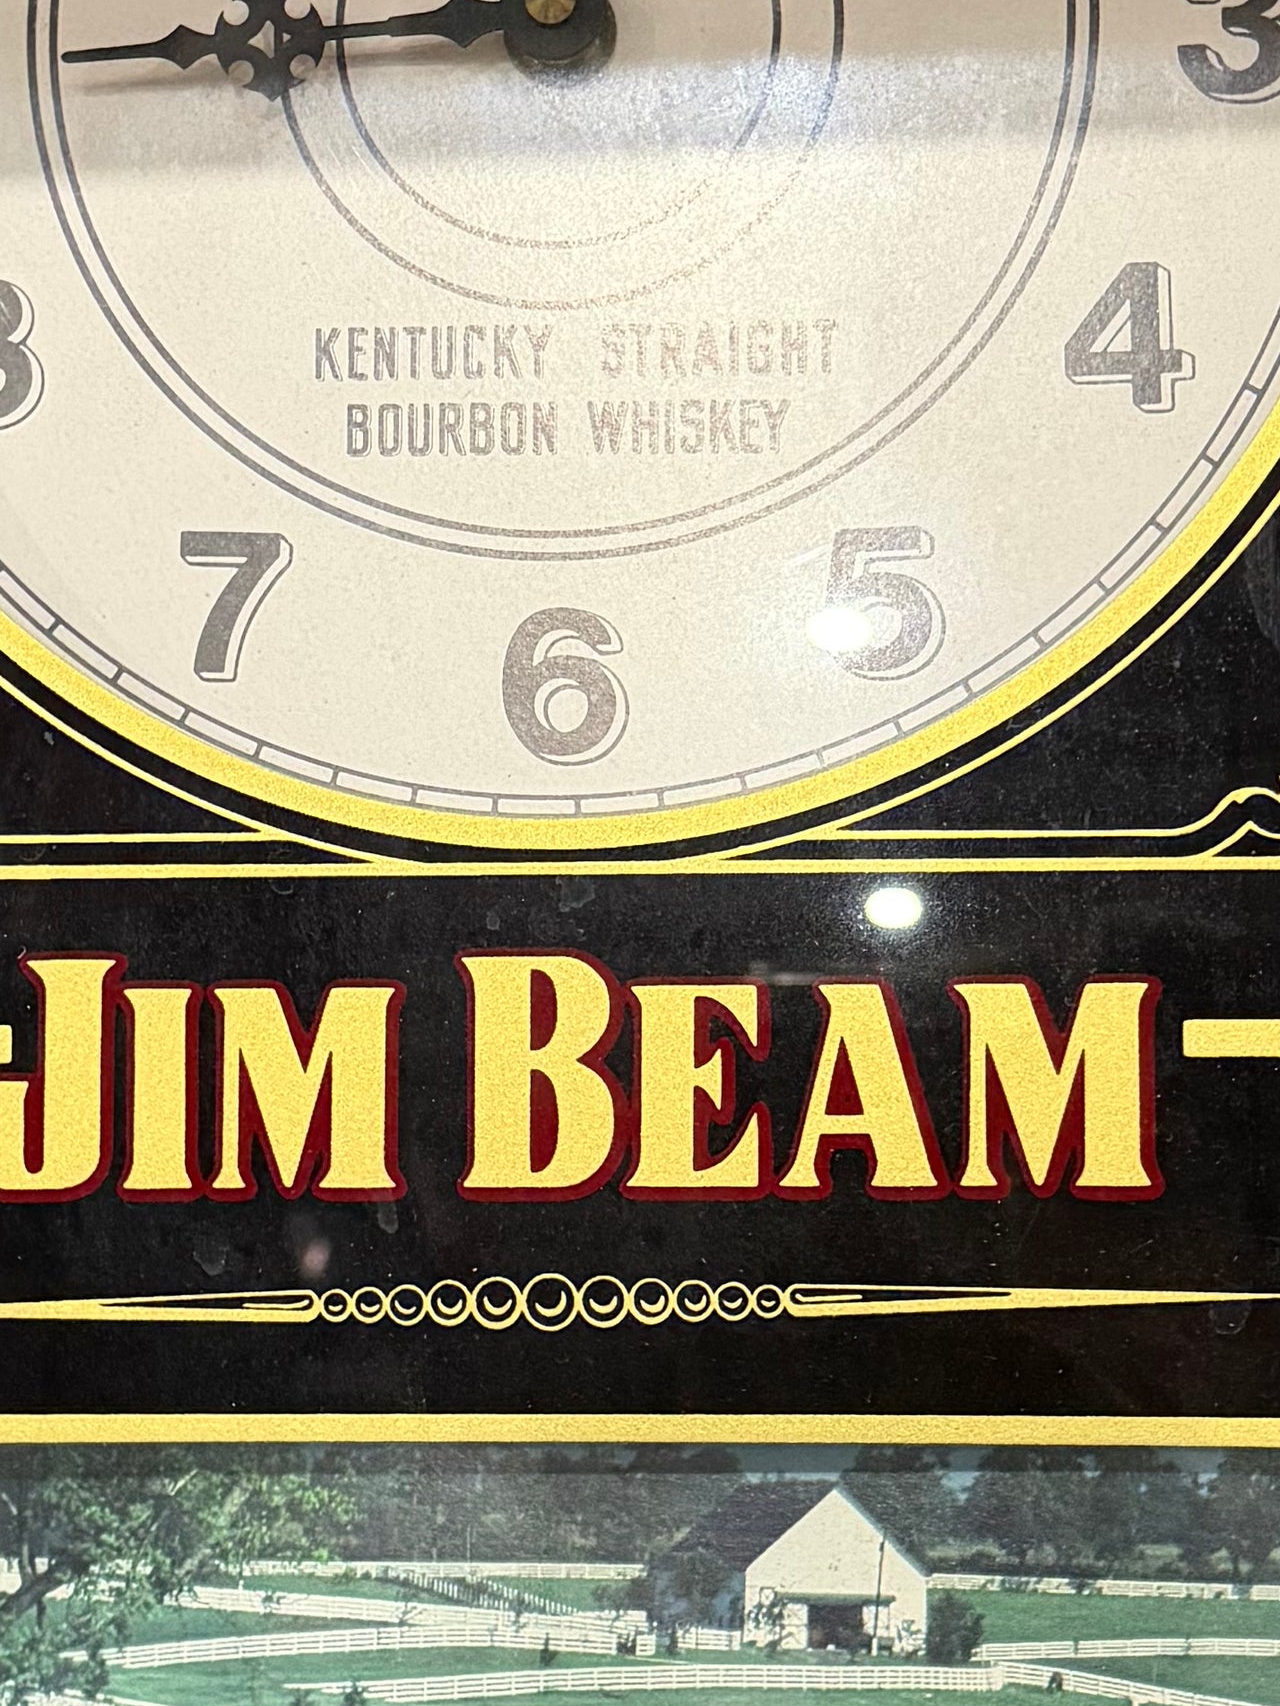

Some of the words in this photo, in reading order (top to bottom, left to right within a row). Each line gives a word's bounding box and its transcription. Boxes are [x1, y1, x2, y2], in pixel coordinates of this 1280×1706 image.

[314, 323, 554, 381] KENTUCKY
[600, 318, 838, 377] STRAIGHT
[1064, 261, 1195, 413] 4
[345, 400, 559, 457] BOURBON
[587, 397, 790, 455] WHISKEY
[180, 531, 293, 682] 7
[820, 525, 947, 682] 5
[503, 607, 630, 766] 6
[454, 948, 1164, 1202] BEAM
